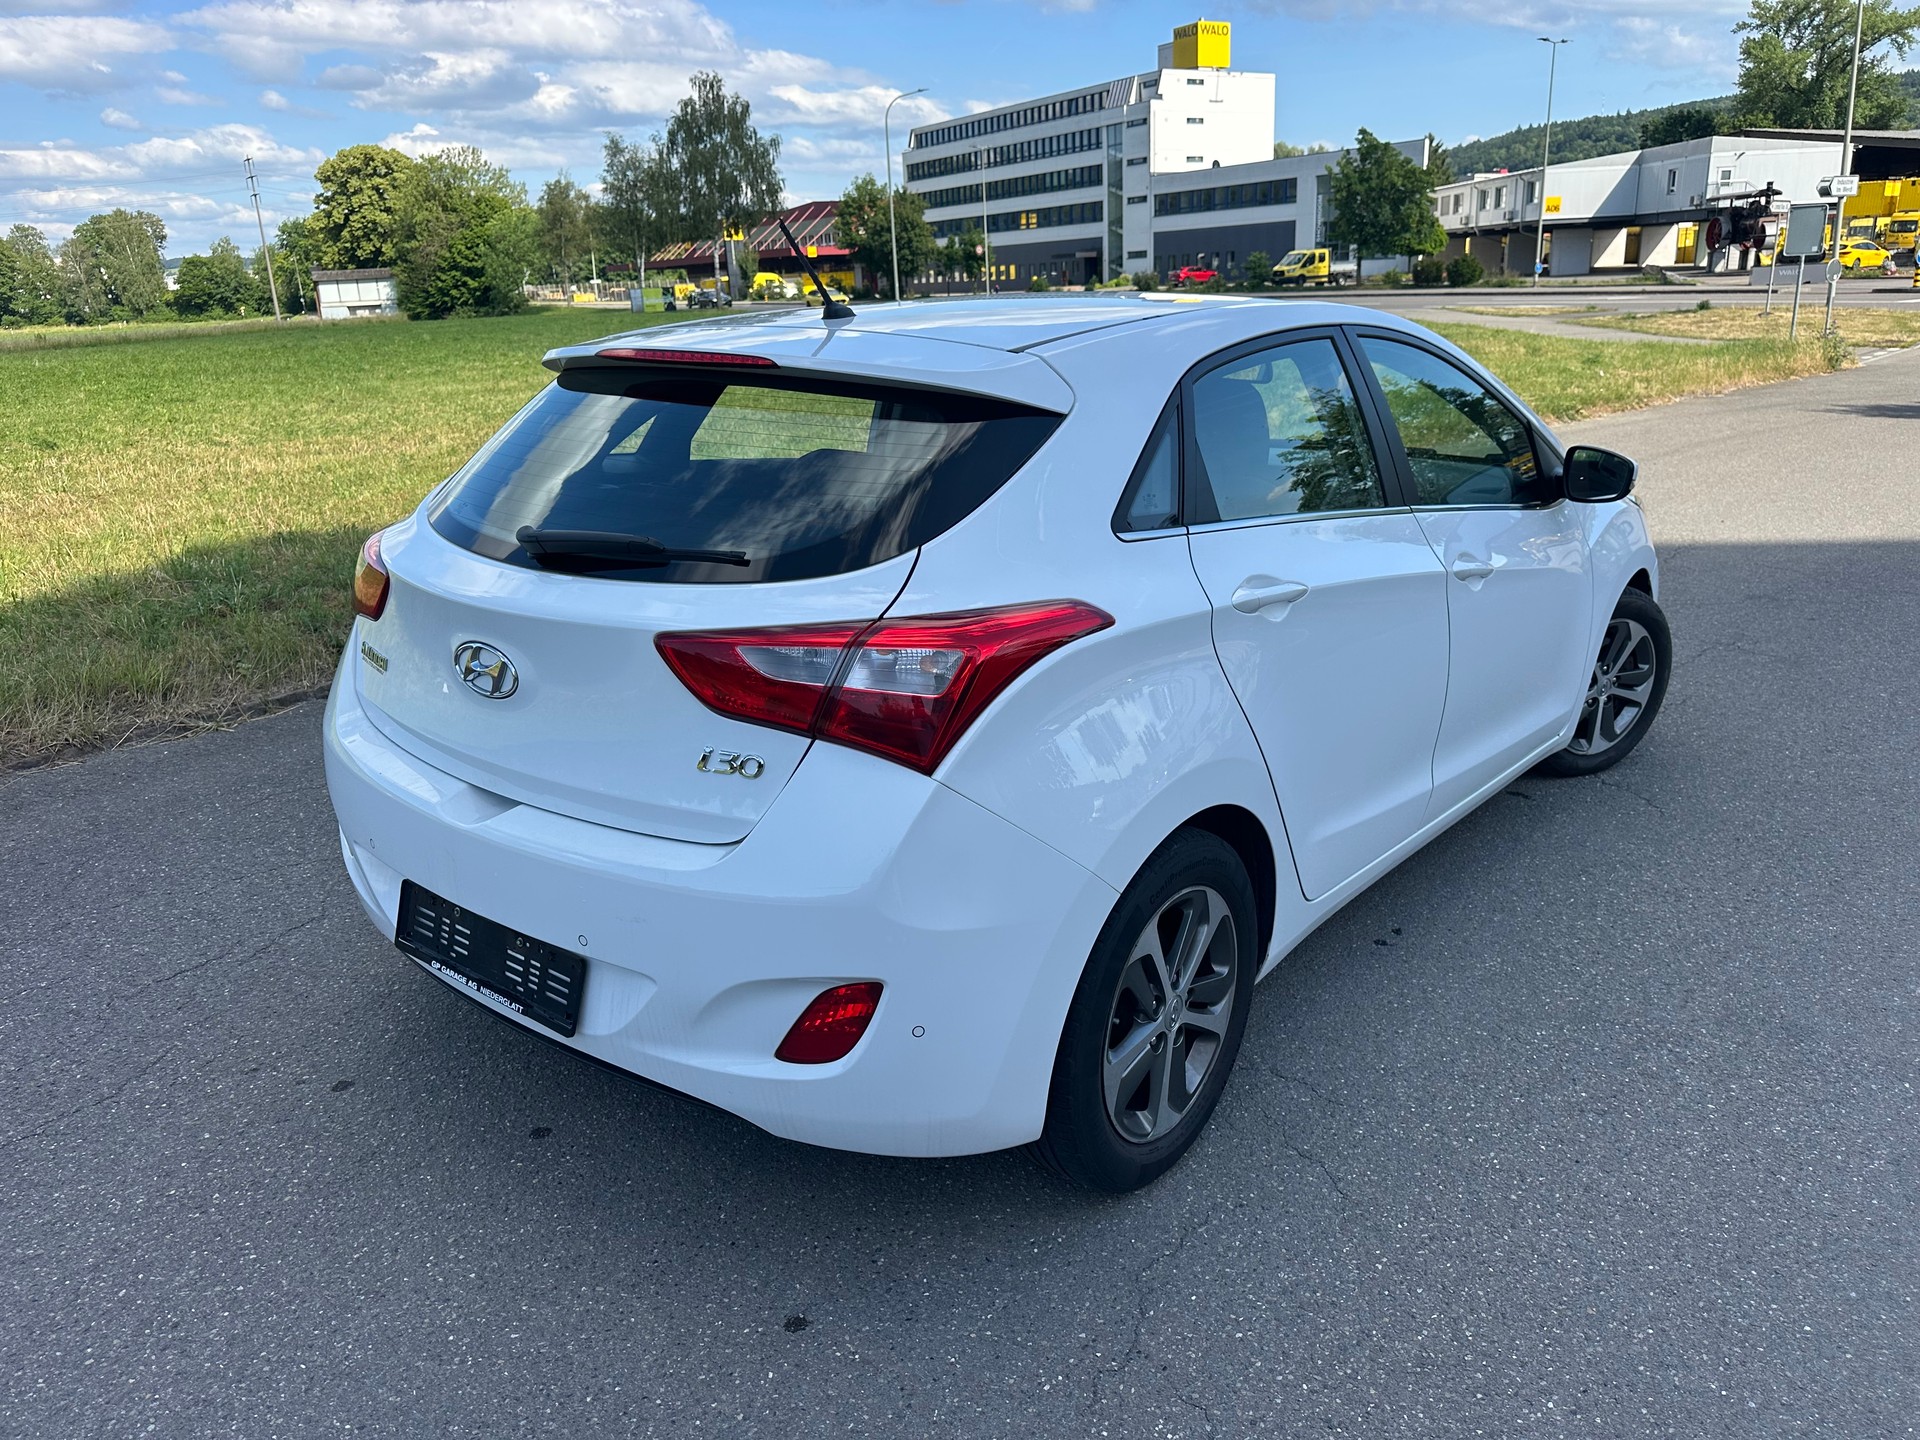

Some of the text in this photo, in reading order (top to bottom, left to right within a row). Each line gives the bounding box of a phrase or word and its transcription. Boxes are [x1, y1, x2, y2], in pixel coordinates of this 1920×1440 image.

[1174, 24, 1197, 40] WALO
[1200, 24, 1229, 36] WALO
[697, 745, 766, 780] i30
[431, 960, 524, 1014] GP GARAGE AG NIEDERGLATT
